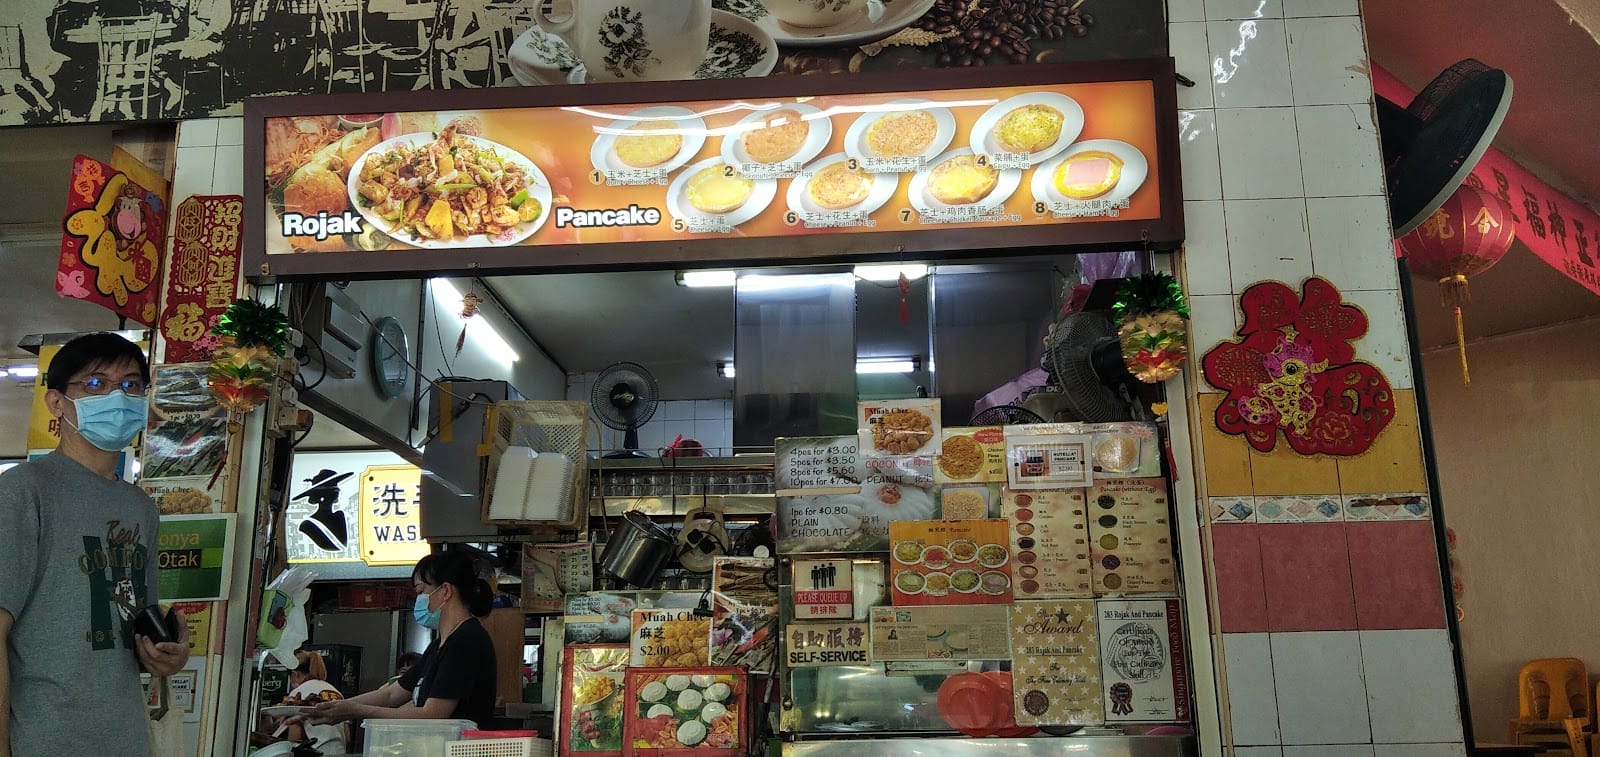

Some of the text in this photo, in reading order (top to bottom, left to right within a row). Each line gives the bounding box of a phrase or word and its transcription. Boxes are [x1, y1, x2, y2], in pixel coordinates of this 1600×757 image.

[848, 158, 857, 169] 3
[977, 155, 986, 166] 4
[593, 171, 600, 182] 1
[724, 165, 734, 177] 2
[1035, 202, 1045, 213] 8
[556, 205, 661, 227] Pancake
[786, 212, 796, 223] 6
[901, 210, 911, 222] 7
[283, 212, 364, 240] Rojak
[674, 218, 684, 230] 5
[814, 447, 825, 455] for
[827, 445, 857, 455] $3.00
[812, 457, 824, 466] for
[812, 467, 823, 476] for
[816, 477, 827, 485] for
[866, 475, 905, 483] PEANUT
[805, 507, 817, 516] for
[819, 506, 848, 515] $0.80
[791, 518, 819, 527] PLAIN
[373, 524, 425, 542] WAS
[791, 527, 850, 538] CHOCOLATE
[158, 549, 200, 568] Otak
[797, 592, 848, 604] PLEASE QUEUE UP
[640, 611, 673, 623] Muah
[1114, 610, 1130, 621] Rojak
[1131, 610, 1142, 619] And
[1143, 609, 1164, 619] Pancake
[1023, 618, 1084, 634] Award
[639, 627, 665, 643] 麻芝
[639, 646, 670, 659] $2.00
[789, 650, 867, 664] SELF-SERVICE
